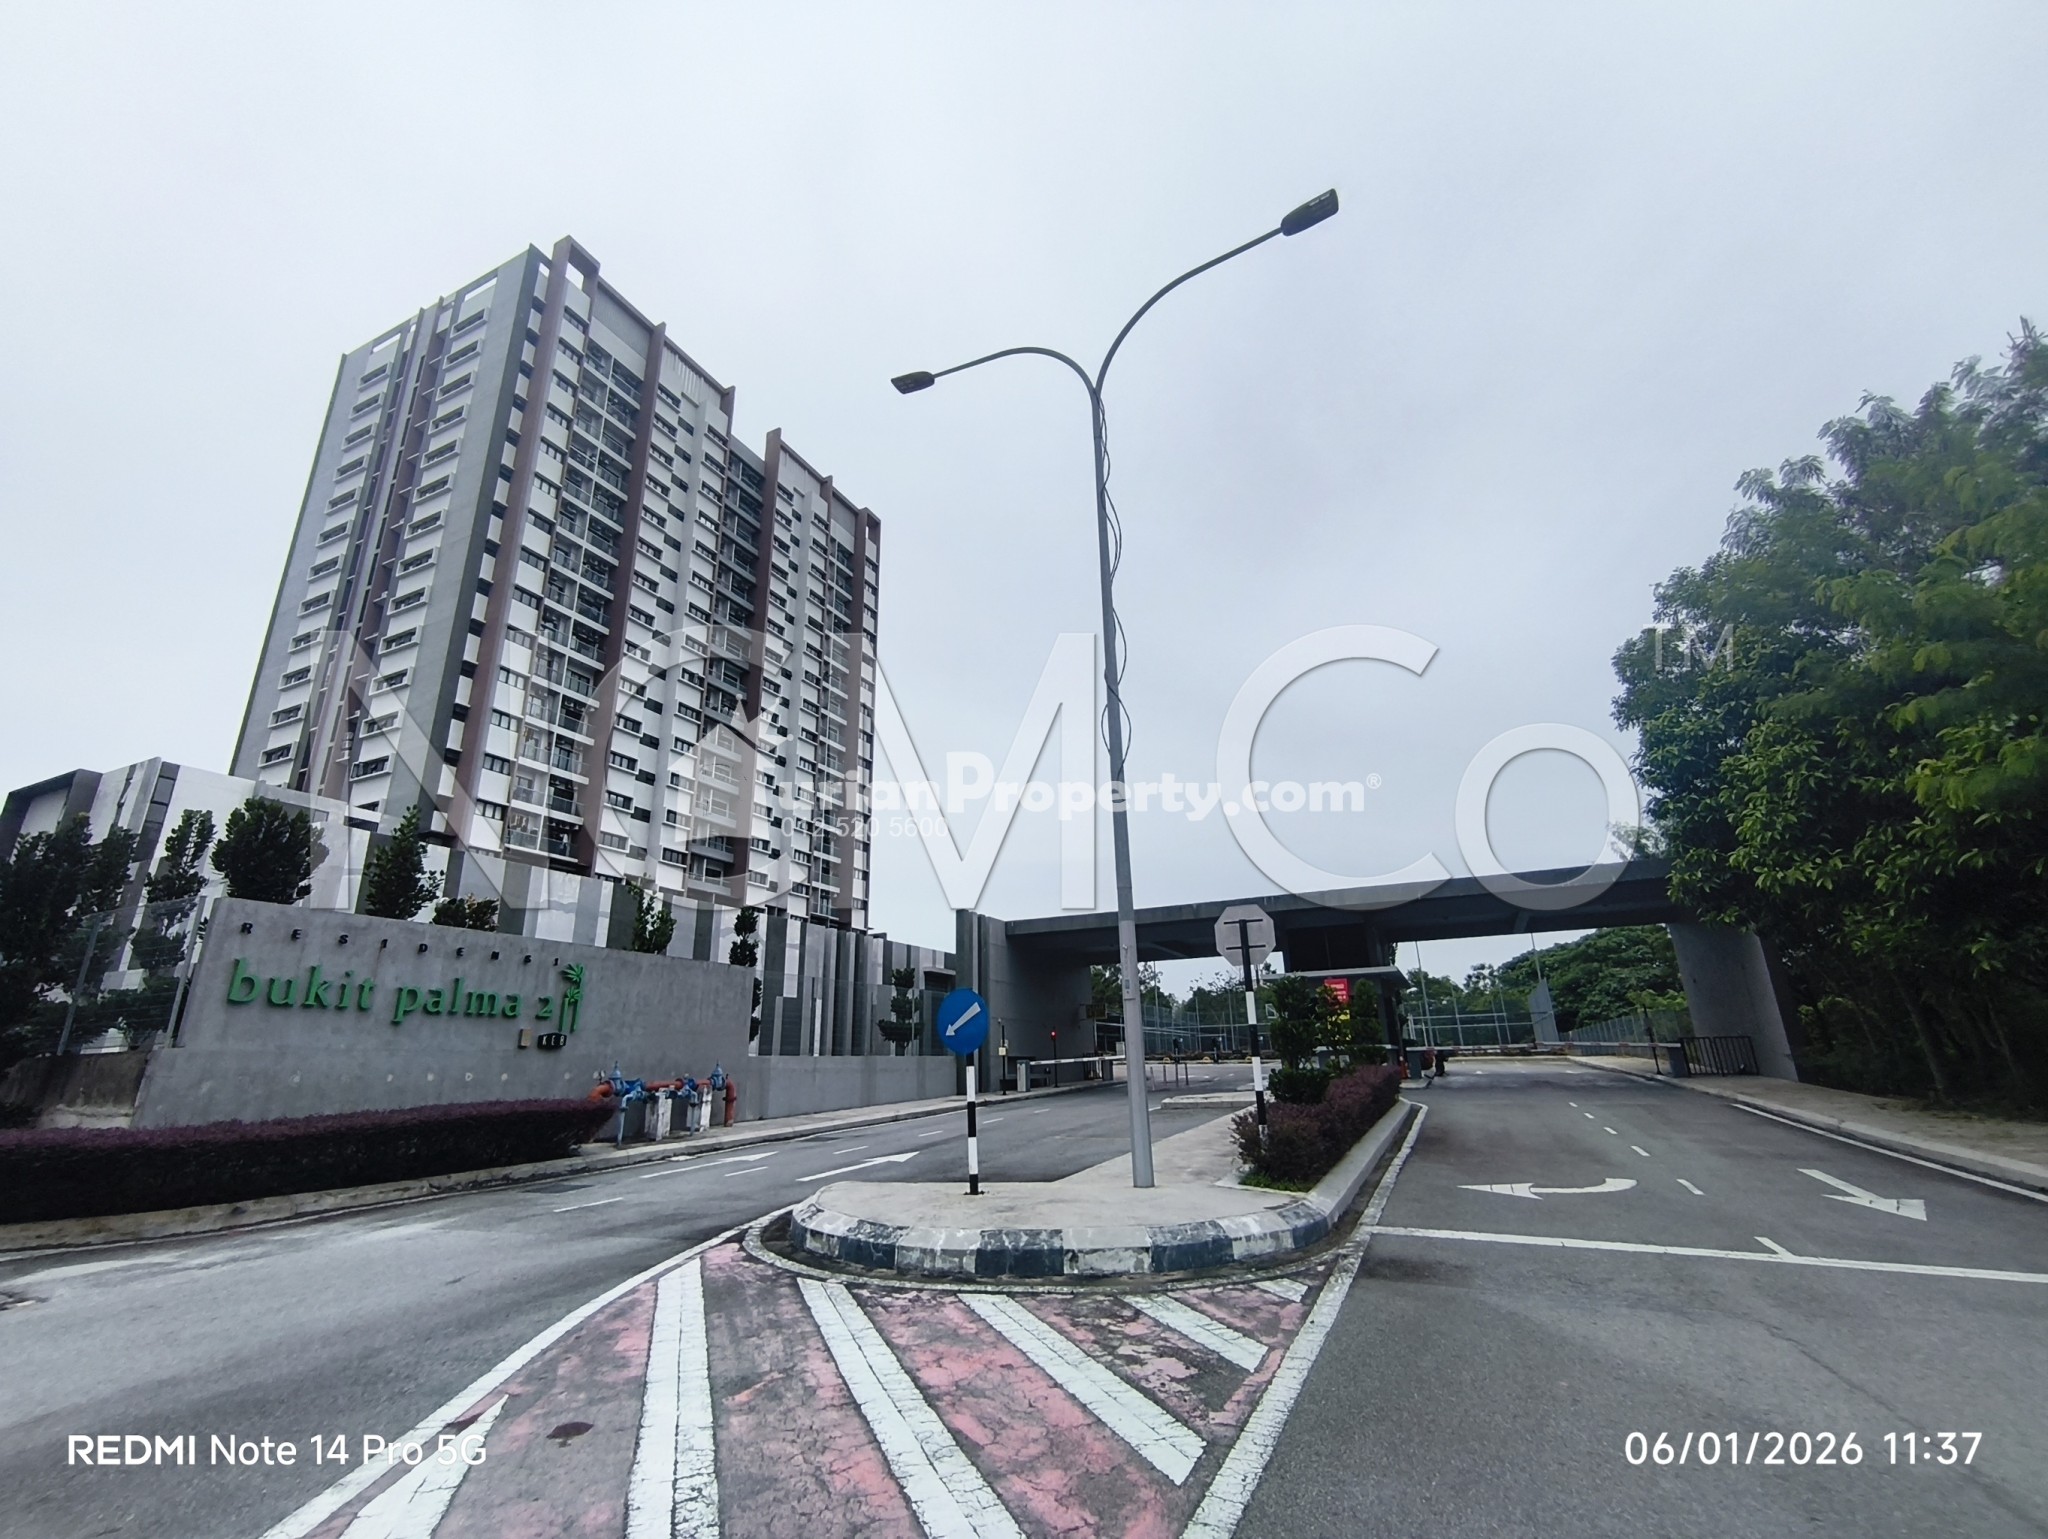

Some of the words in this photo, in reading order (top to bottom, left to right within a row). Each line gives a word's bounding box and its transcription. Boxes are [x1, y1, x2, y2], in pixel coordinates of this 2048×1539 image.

[227, 957, 375, 1012] bukit
[391, 977, 523, 1025] palma
[535, 995, 553, 1020] 2
